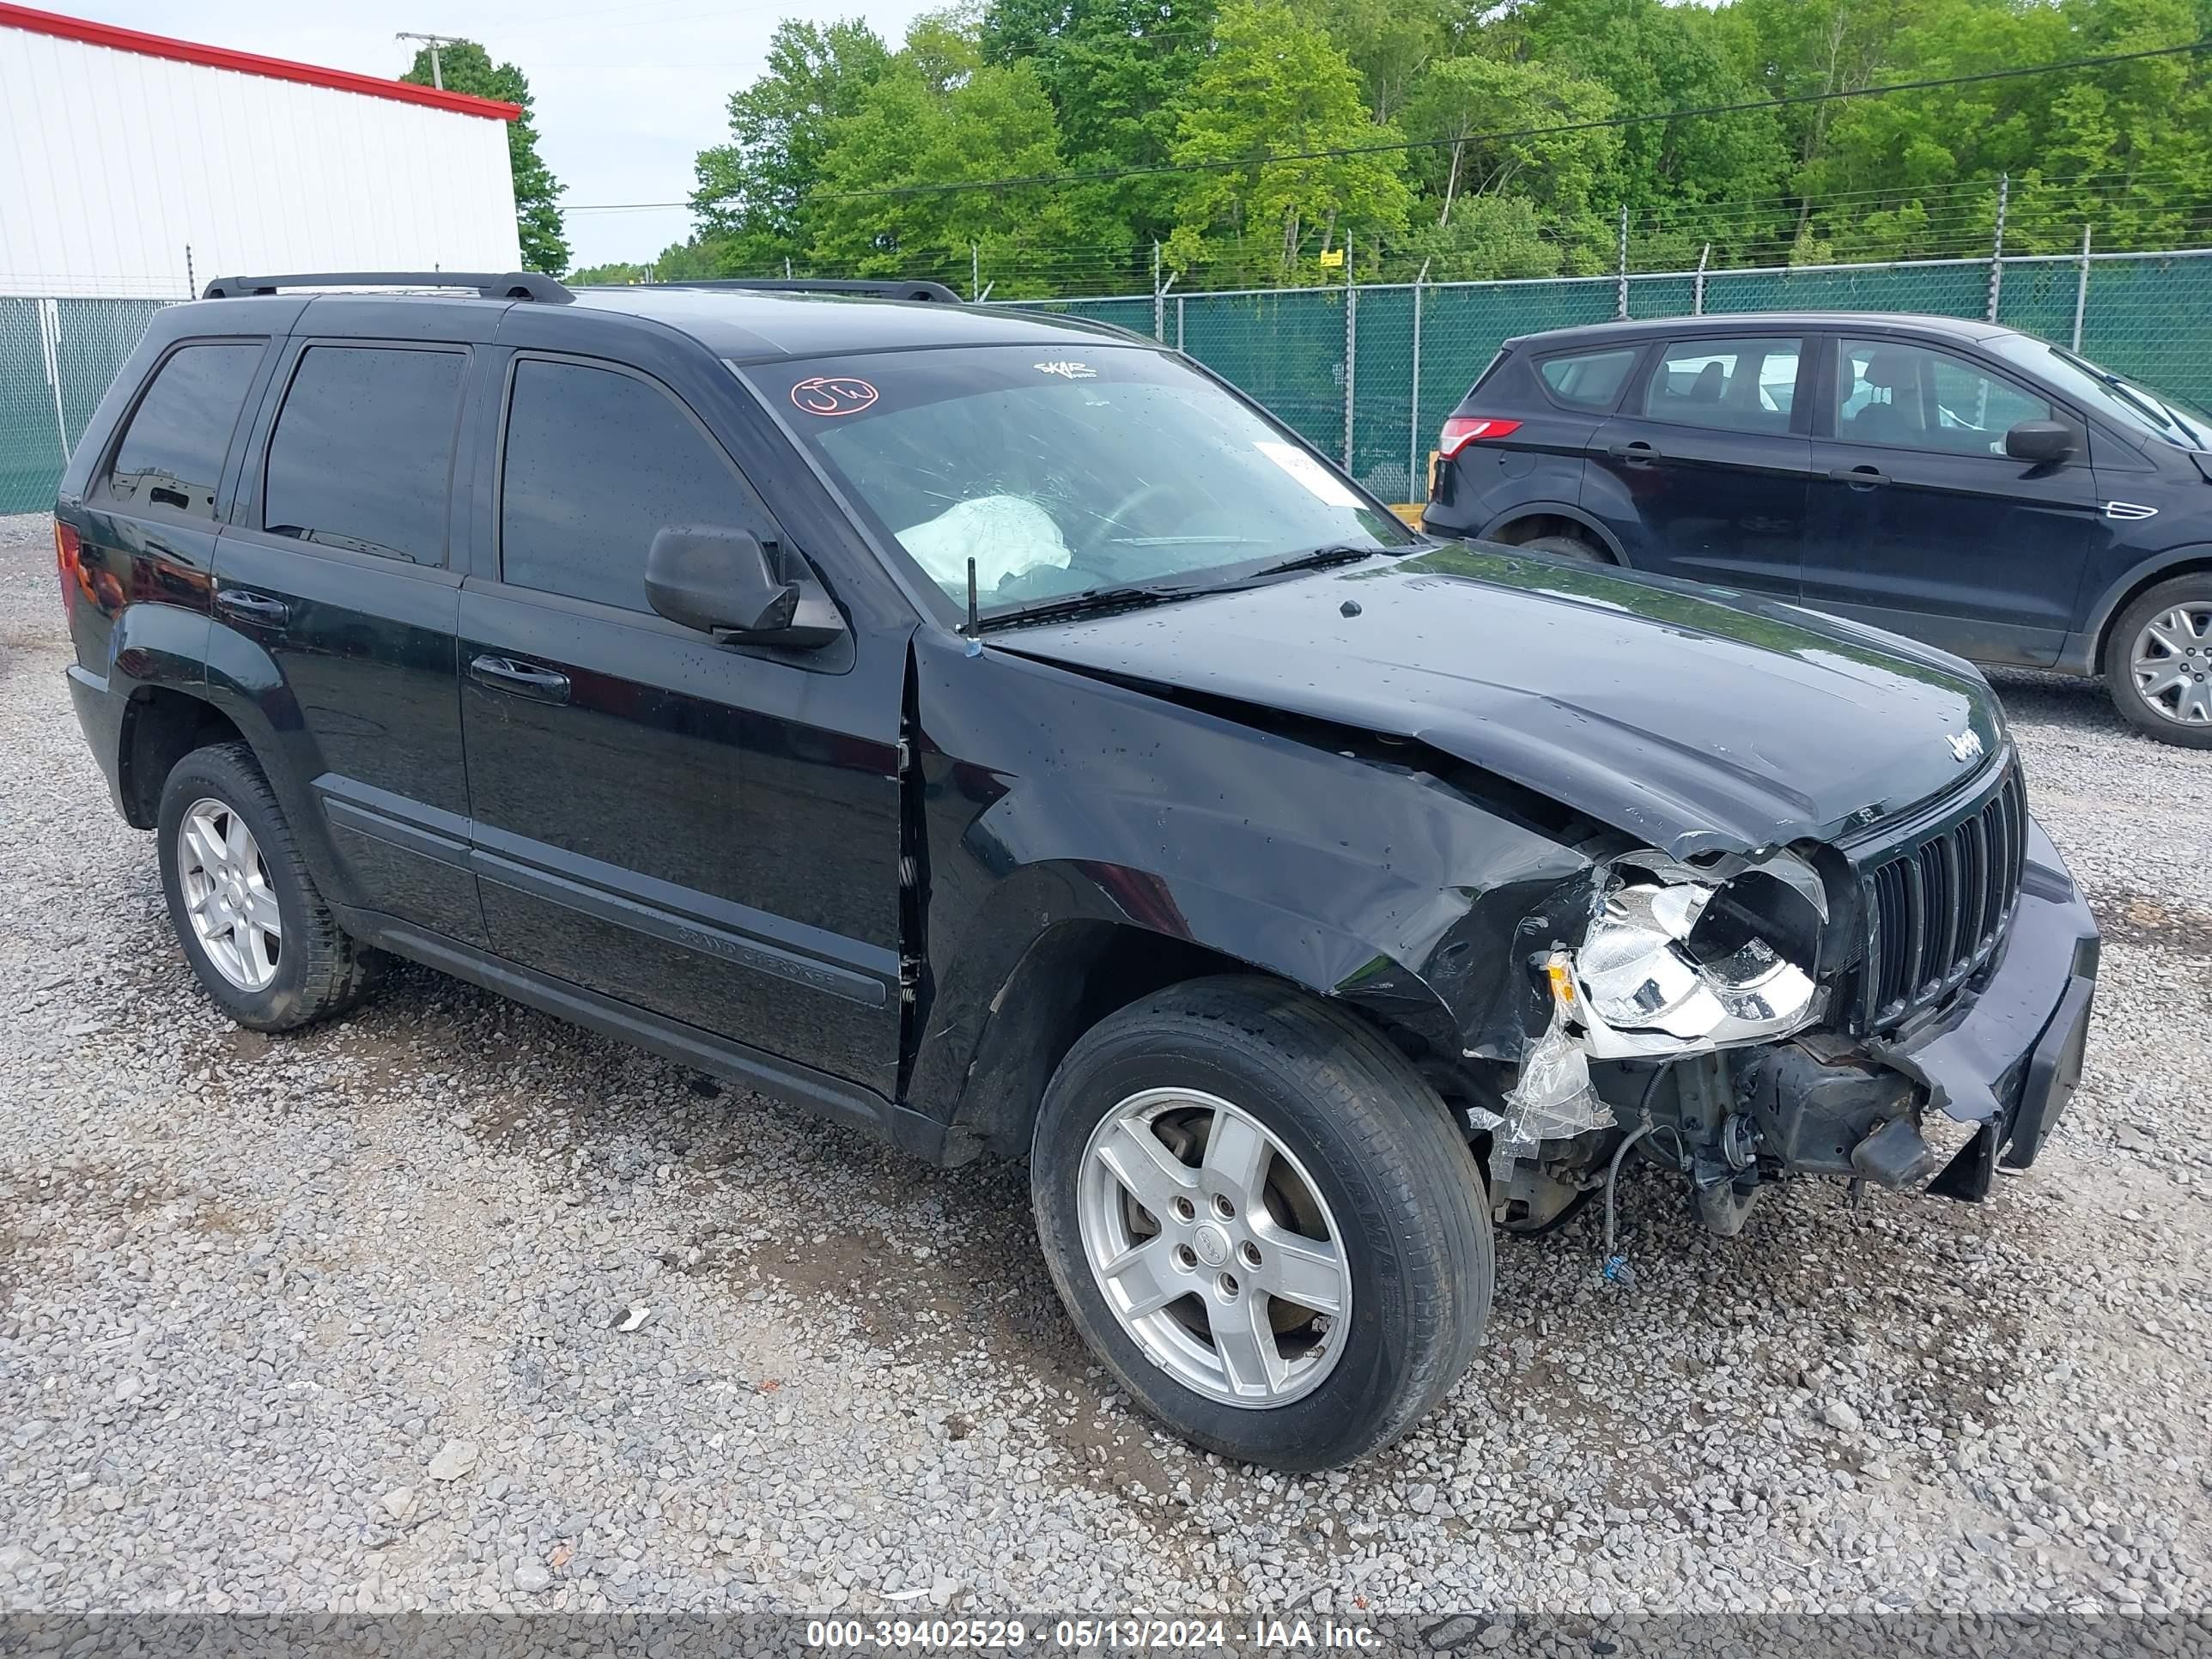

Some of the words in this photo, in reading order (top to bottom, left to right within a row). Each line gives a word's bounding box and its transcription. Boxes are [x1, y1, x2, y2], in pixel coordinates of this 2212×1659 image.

[1033, 361, 1097, 379] SKAR
[678, 927, 736, 954] GRAND
[742, 947, 836, 982] CHEROKEE
